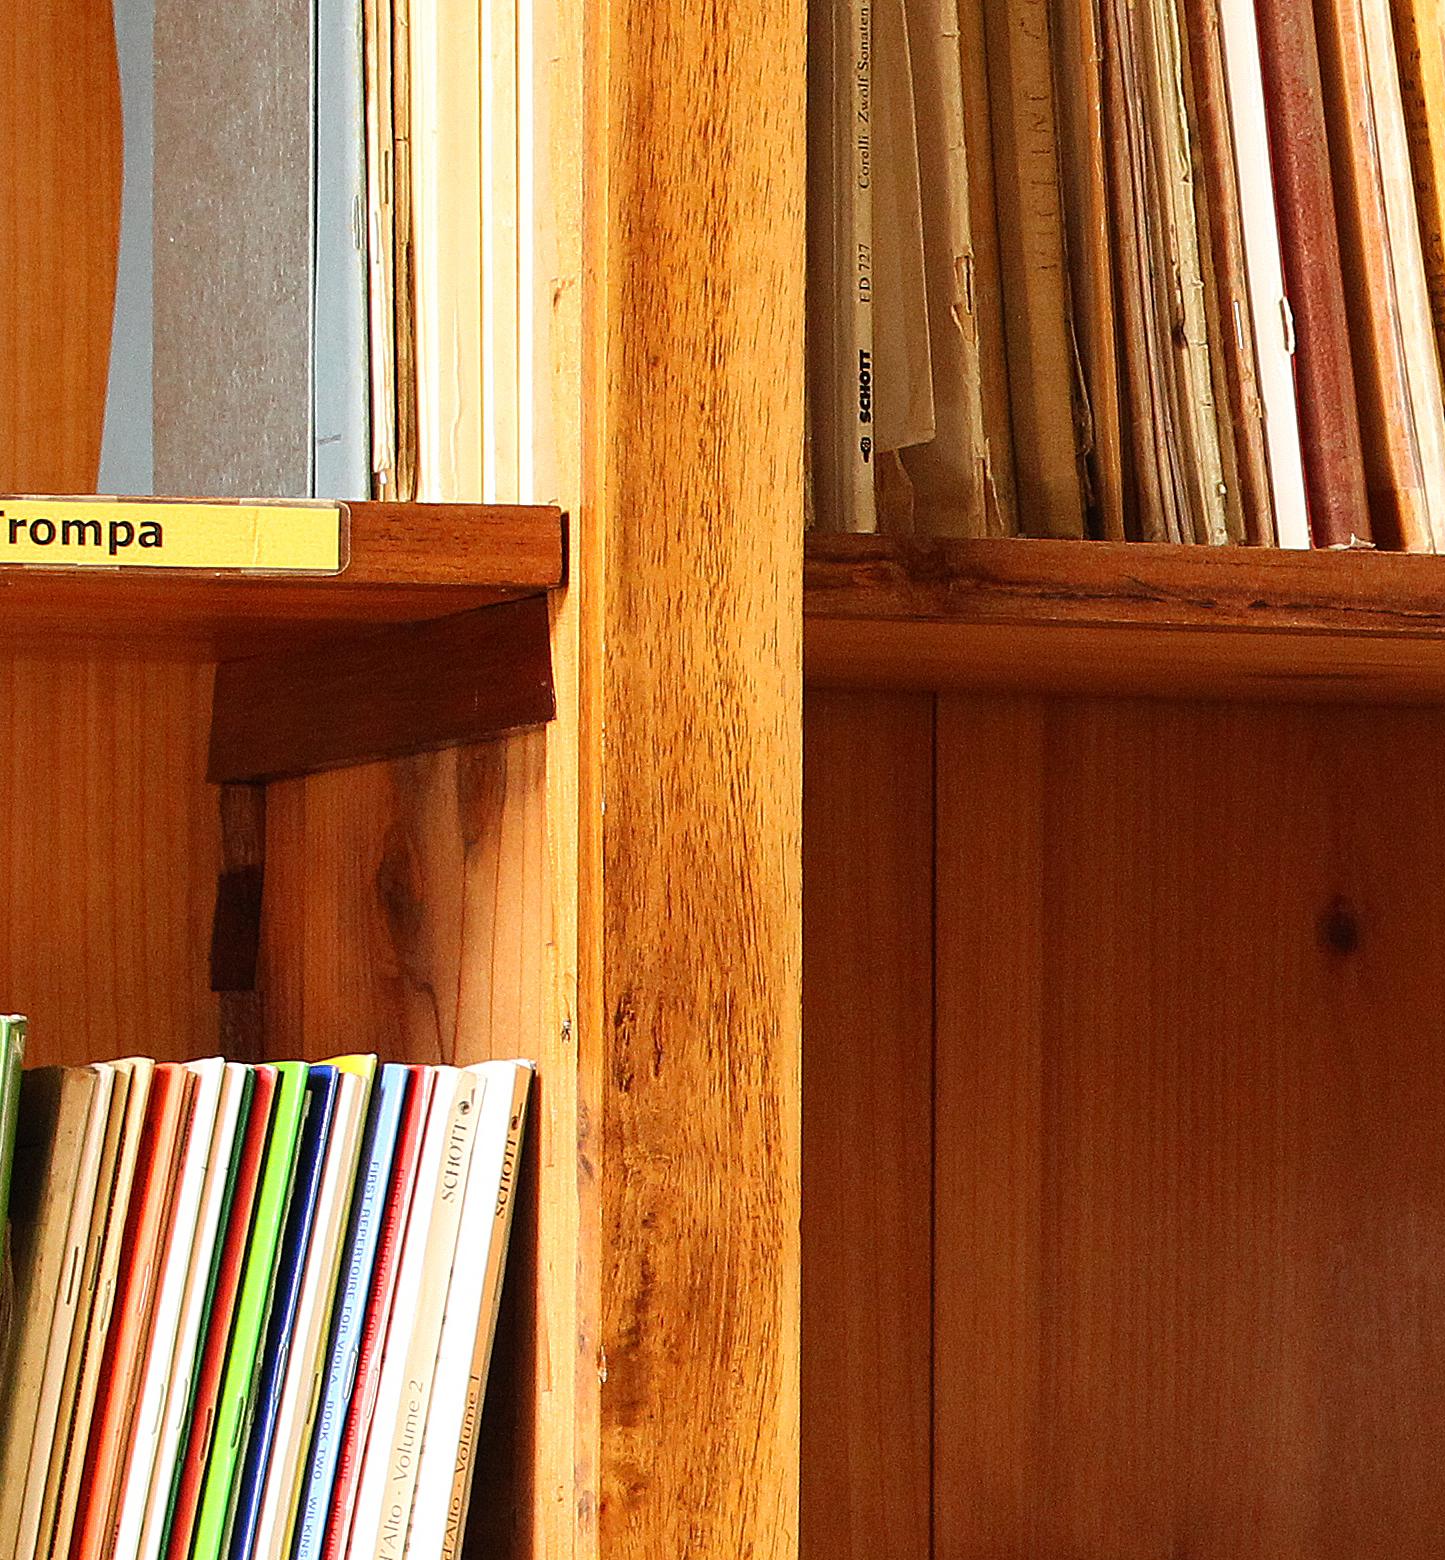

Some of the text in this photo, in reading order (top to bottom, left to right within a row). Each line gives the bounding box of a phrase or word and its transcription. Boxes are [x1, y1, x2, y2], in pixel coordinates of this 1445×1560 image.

[857, 7, 870, 71] Sonaten
[858, 135, 870, 189] Corelli
[858, 244, 870, 272] 727
[859, 349, 872, 424] SCHOTT
[0, 510, 163, 556] rompa
[363, 1160, 381, 1210] FIRST
[441, 1122, 468, 1204] SCHOTT
[495, 1133, 519, 1220] SCHOTT
[346, 1208, 375, 1299] REPERTOIRE
[339, 1305, 353, 1336] FOR
[330, 1340, 346, 1385] VIOLA
[319, 1401, 335, 1442] BOOK
[392, 1399, 424, 1483] Volume
[408, 1379, 424, 1393] 2
[454, 1391, 478, 1475] Volume
[469, 1374, 481, 1383] 1
[313, 1446, 329, 1482] TWO
